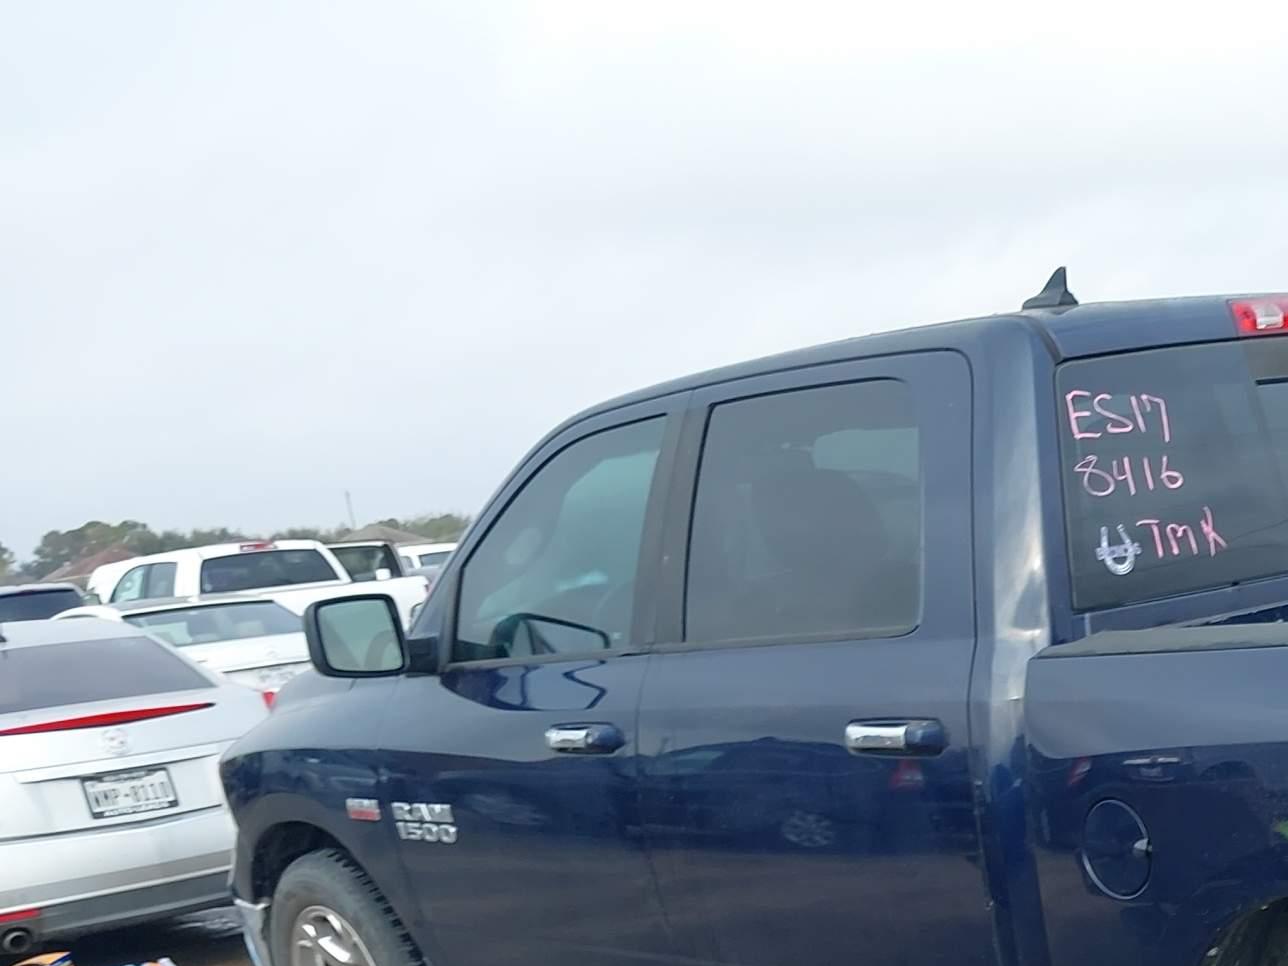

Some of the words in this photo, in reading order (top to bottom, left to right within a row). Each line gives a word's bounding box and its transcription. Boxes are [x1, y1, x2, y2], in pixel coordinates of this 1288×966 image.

[1073, 454, 1184, 496] 8416
[391, 801, 455, 823] RAM
[395, 821, 458, 844] 1500
